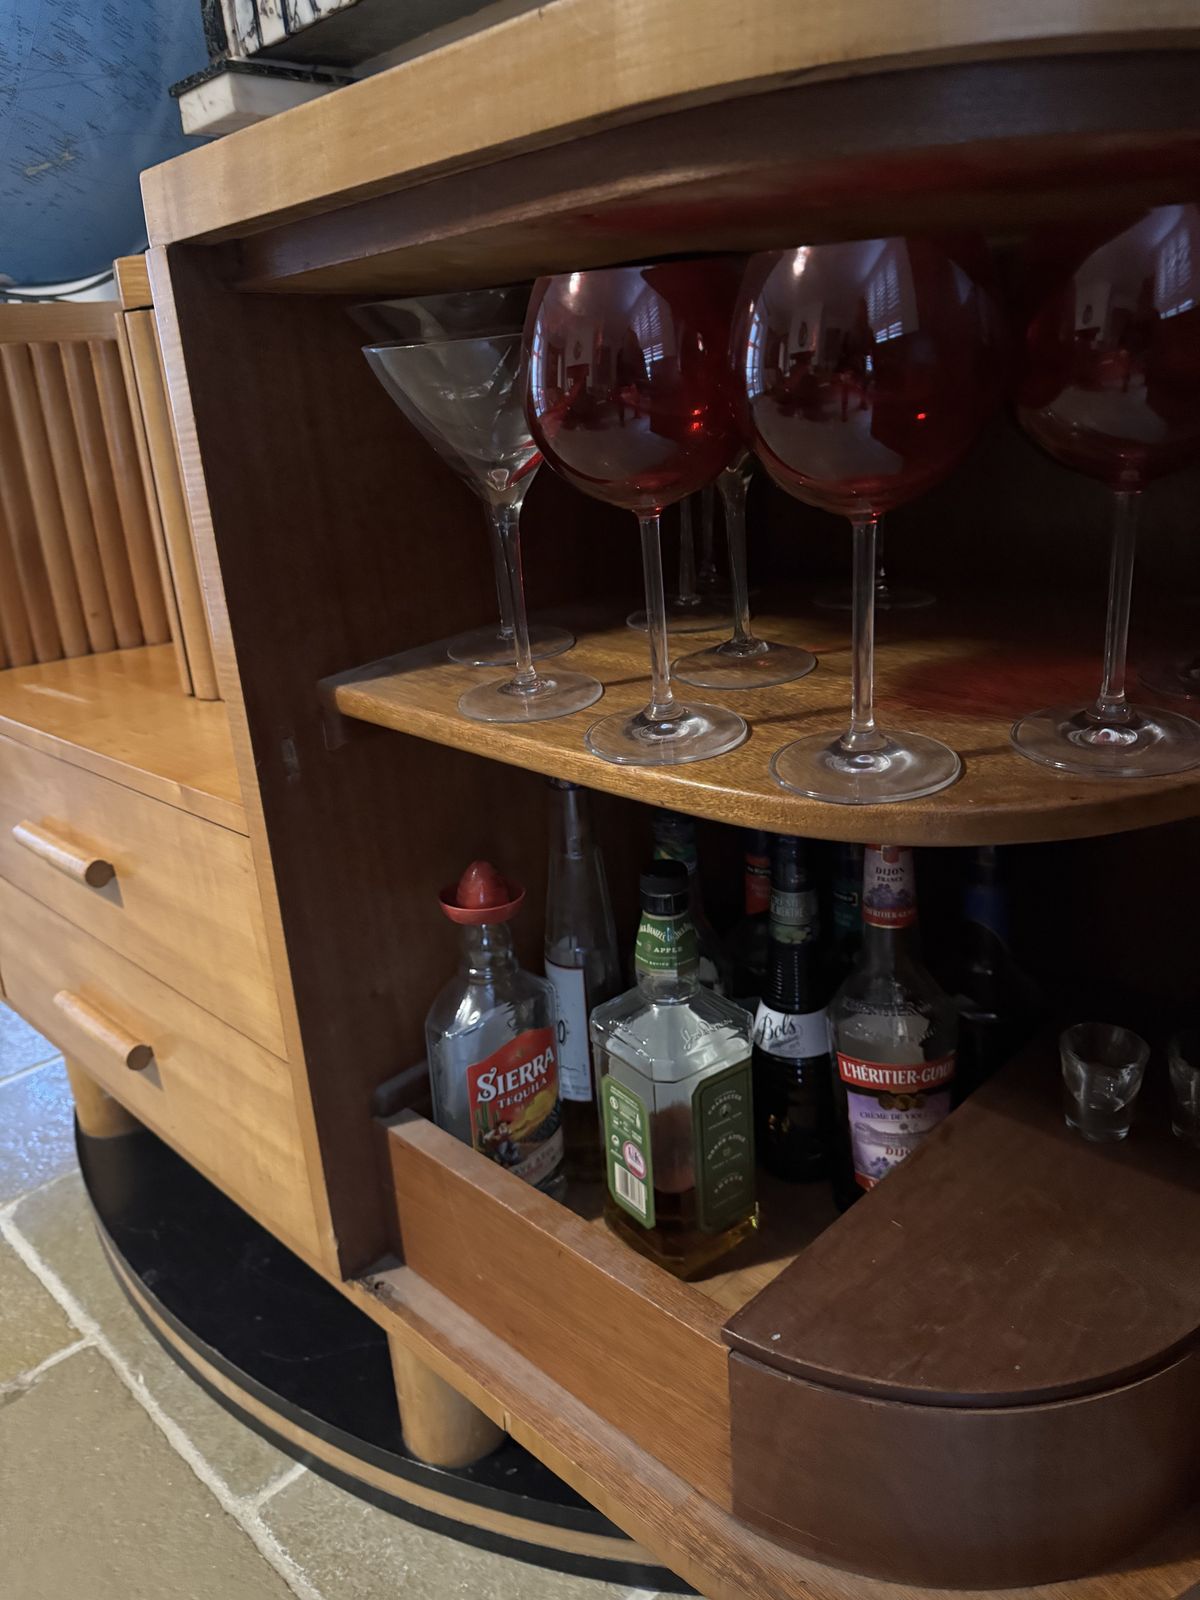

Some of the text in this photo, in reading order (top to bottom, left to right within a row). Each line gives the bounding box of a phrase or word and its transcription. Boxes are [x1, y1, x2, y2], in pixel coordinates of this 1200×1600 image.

[875, 866, 905, 876] DIJON
[653, 946, 684, 954] APPLE
[759, 1012, 796, 1046] Bols
[476, 1045, 555, 1103] SIERRA
[497, 1077, 547, 1109] TEQUILA
[885, 1146, 912, 1157] DIJO
